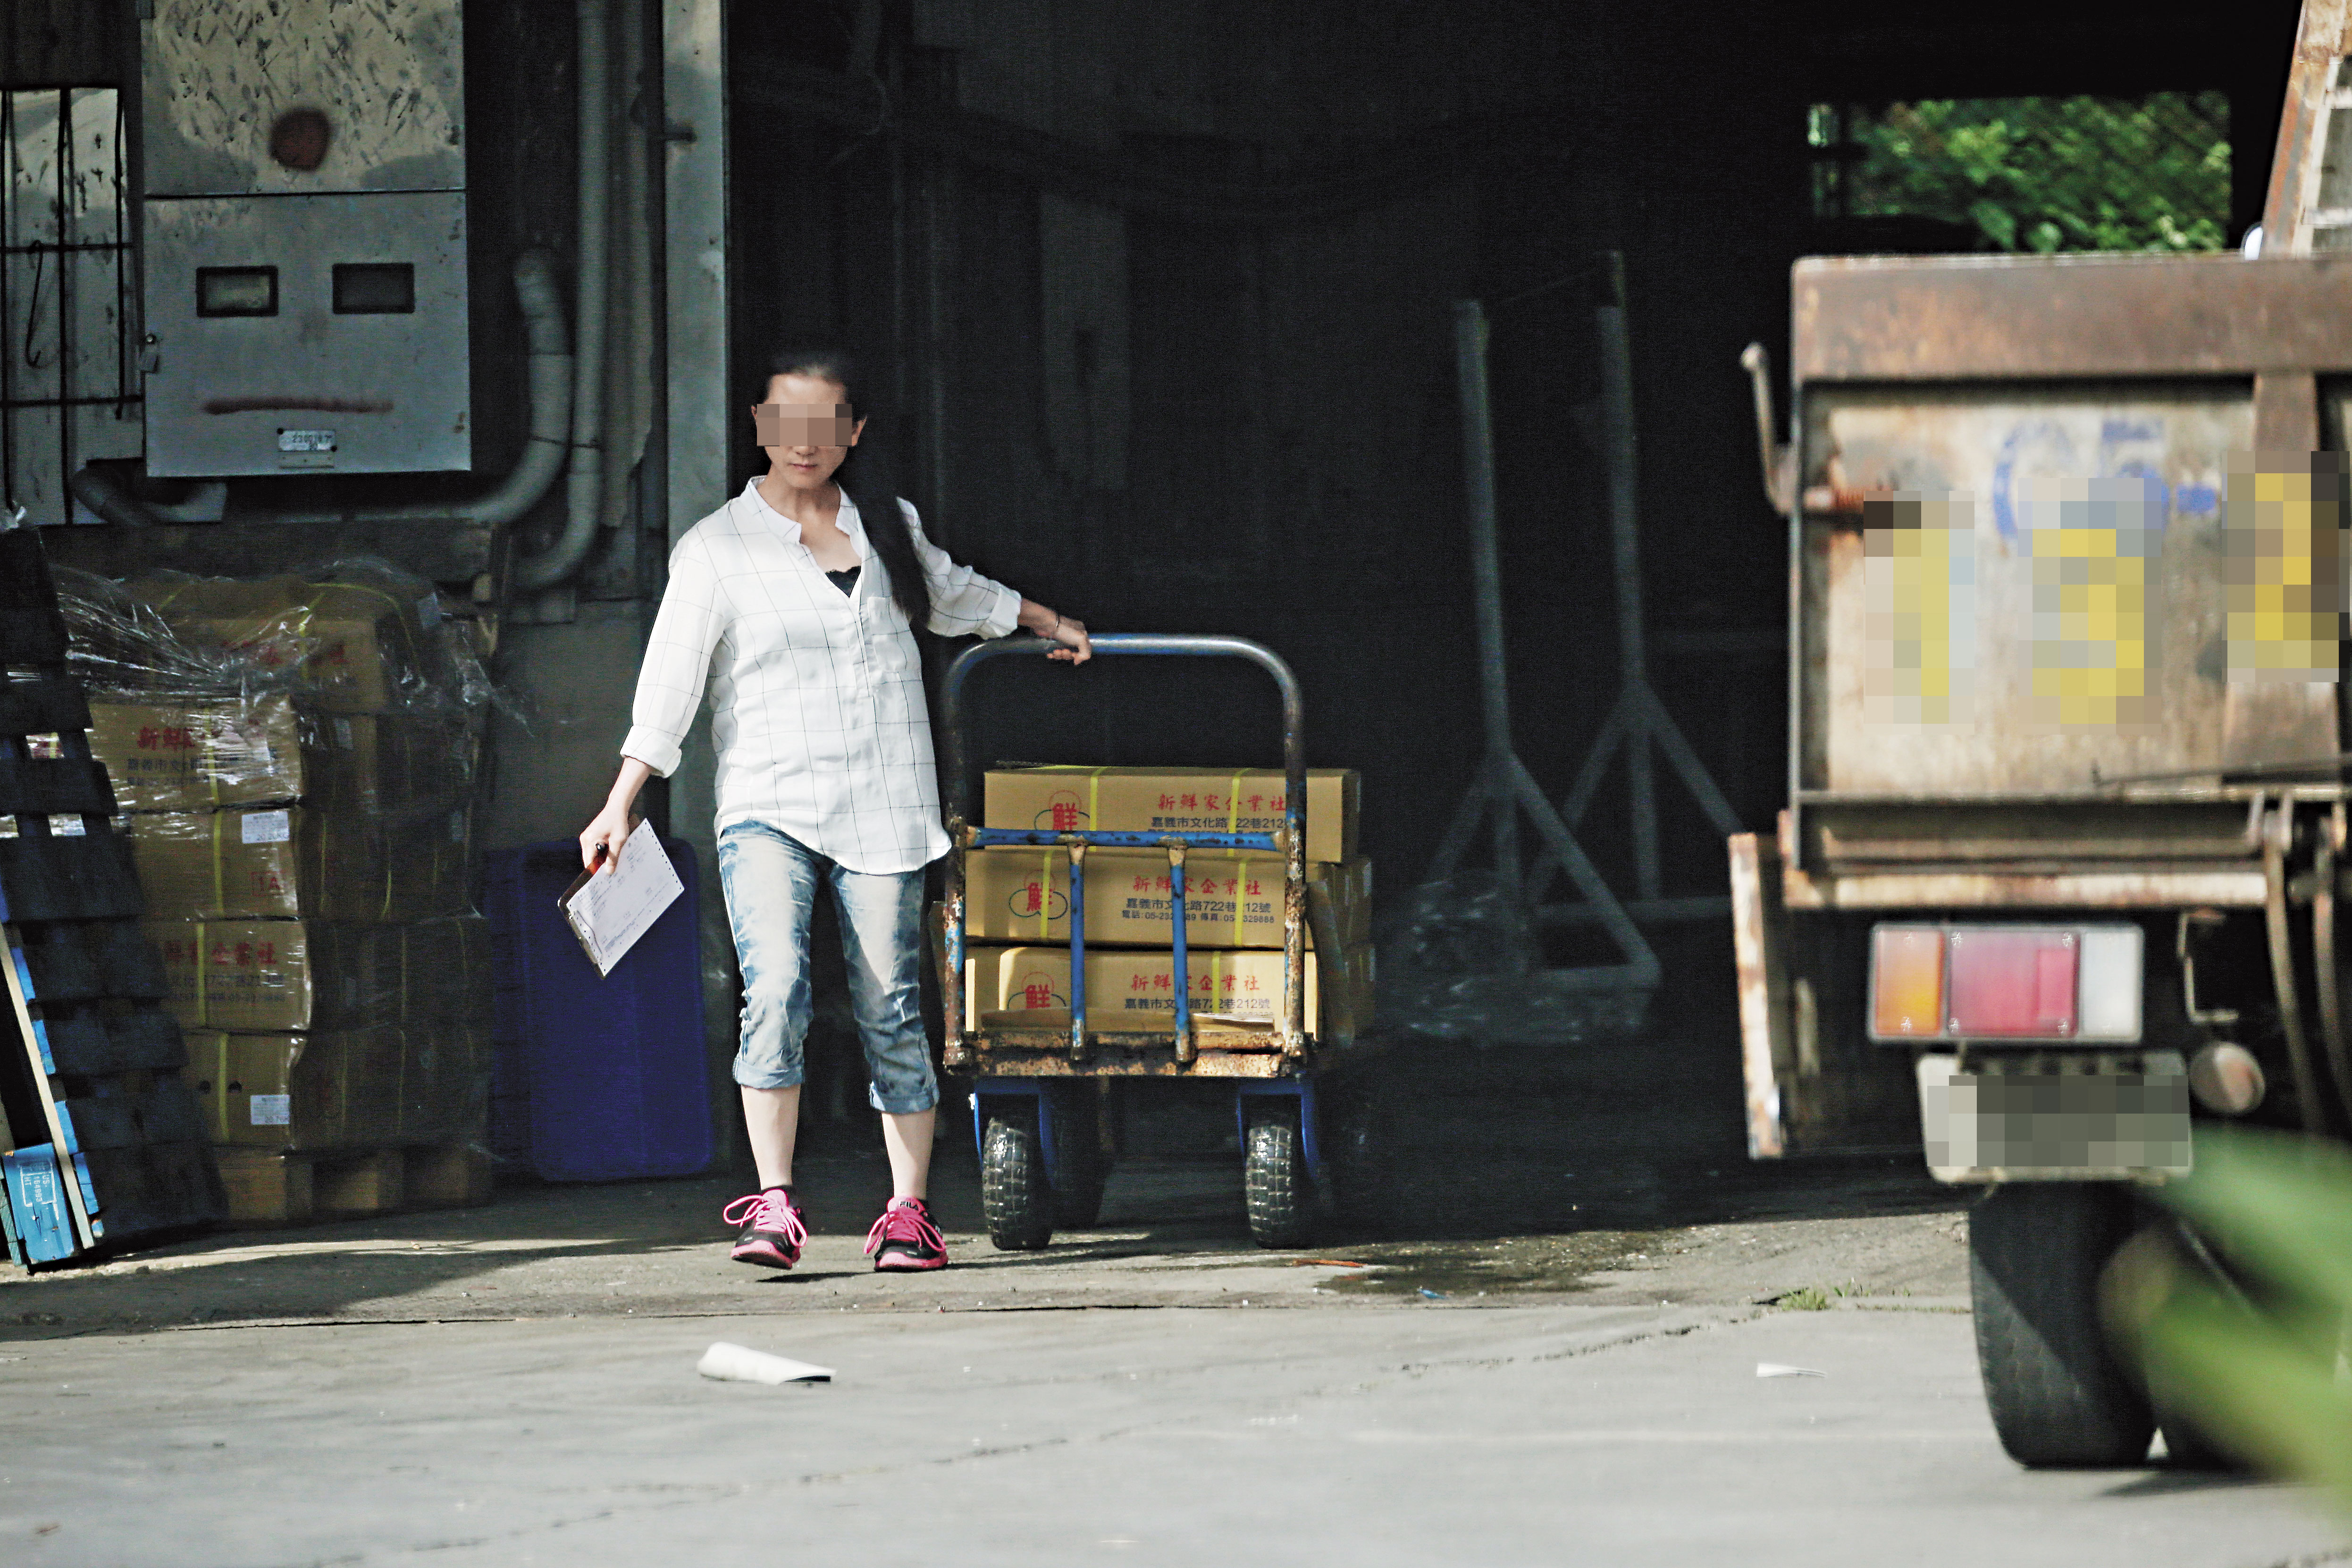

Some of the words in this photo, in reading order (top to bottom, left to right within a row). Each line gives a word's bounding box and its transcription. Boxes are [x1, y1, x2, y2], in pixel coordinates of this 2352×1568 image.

[1151, 817, 1287, 828] 嘉義市文化路22巷212
[1126, 898, 1271, 913] 嘉義市文路722巷12號
[1125, 998, 1270, 1009] 嘉義市文路72巷212號
[899, 1201, 919, 1211] FILA
